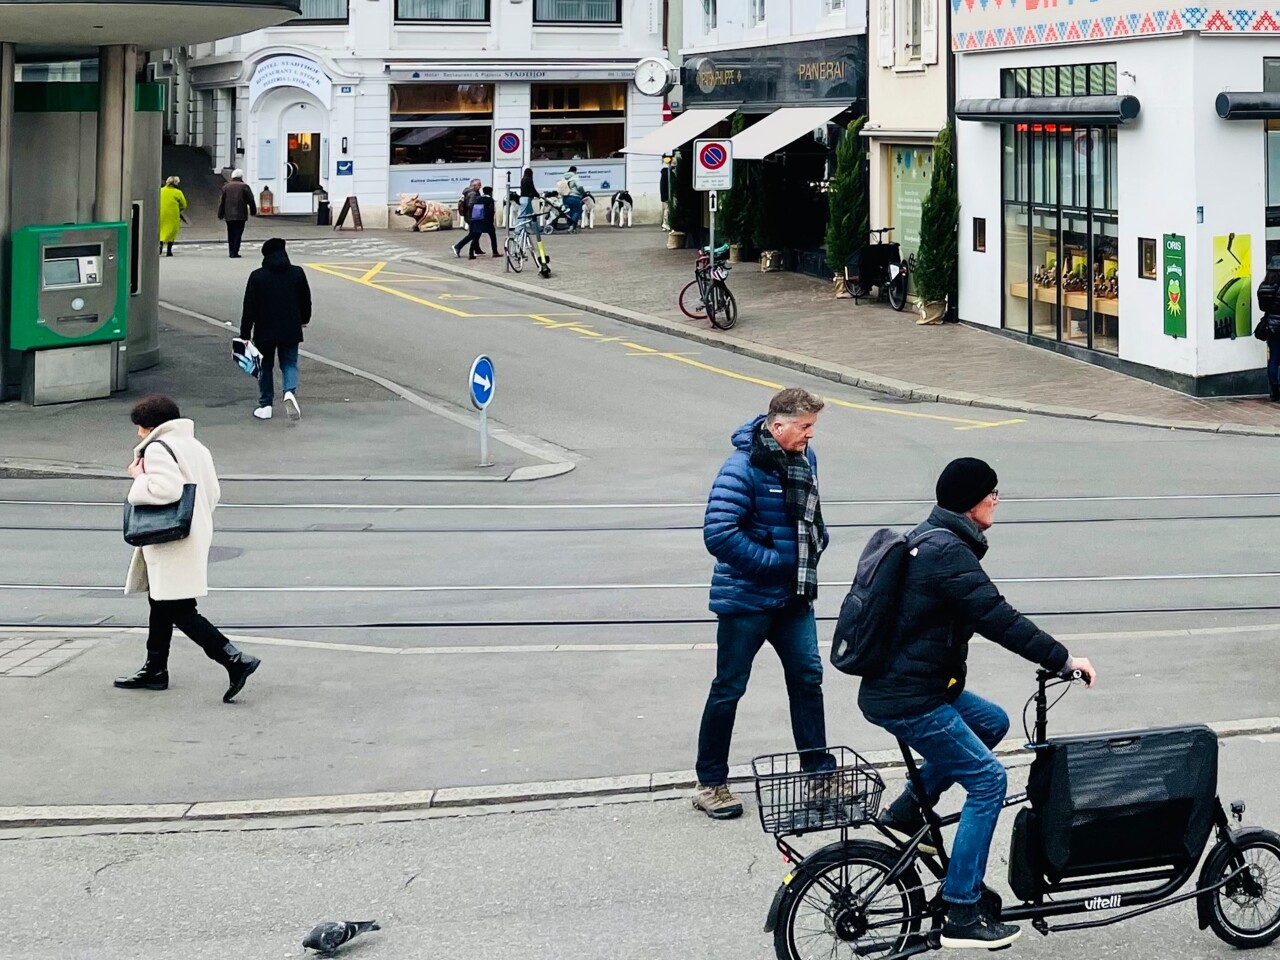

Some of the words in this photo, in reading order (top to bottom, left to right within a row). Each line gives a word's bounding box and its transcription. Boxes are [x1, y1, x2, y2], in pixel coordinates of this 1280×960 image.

[258, 62, 277, 74] HOTEL
[281, 61, 319, 74] STADTHOF
[799, 60, 847, 81] PANERAI
[1166, 240, 1182, 251] ORIS
[1084, 894, 1122, 911] vitelli
